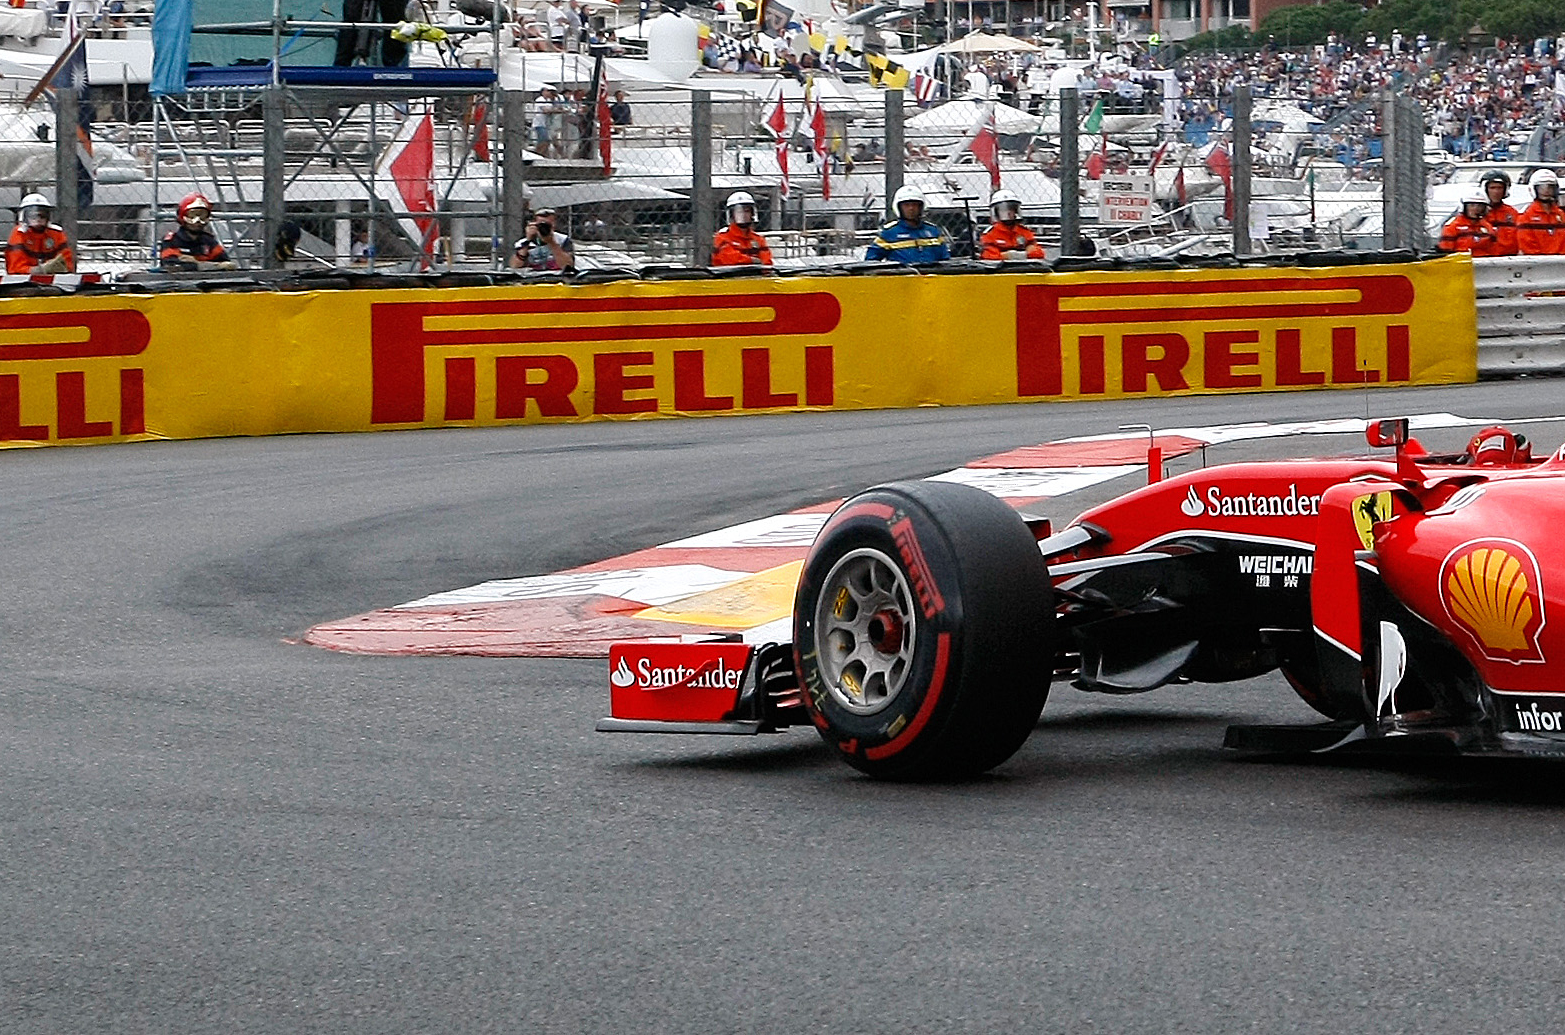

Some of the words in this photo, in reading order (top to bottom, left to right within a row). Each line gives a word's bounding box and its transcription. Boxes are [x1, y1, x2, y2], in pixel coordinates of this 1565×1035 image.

[370, 291, 842, 424] PIRELLI
[1016, 274, 1415, 397] PIRELLI
[1207, 483, 1321, 516] Santander
[890, 517, 946, 620] PIRELLI
[1238, 555, 1313, 574] WEICHAI
[1515, 702, 1563, 732] infor
